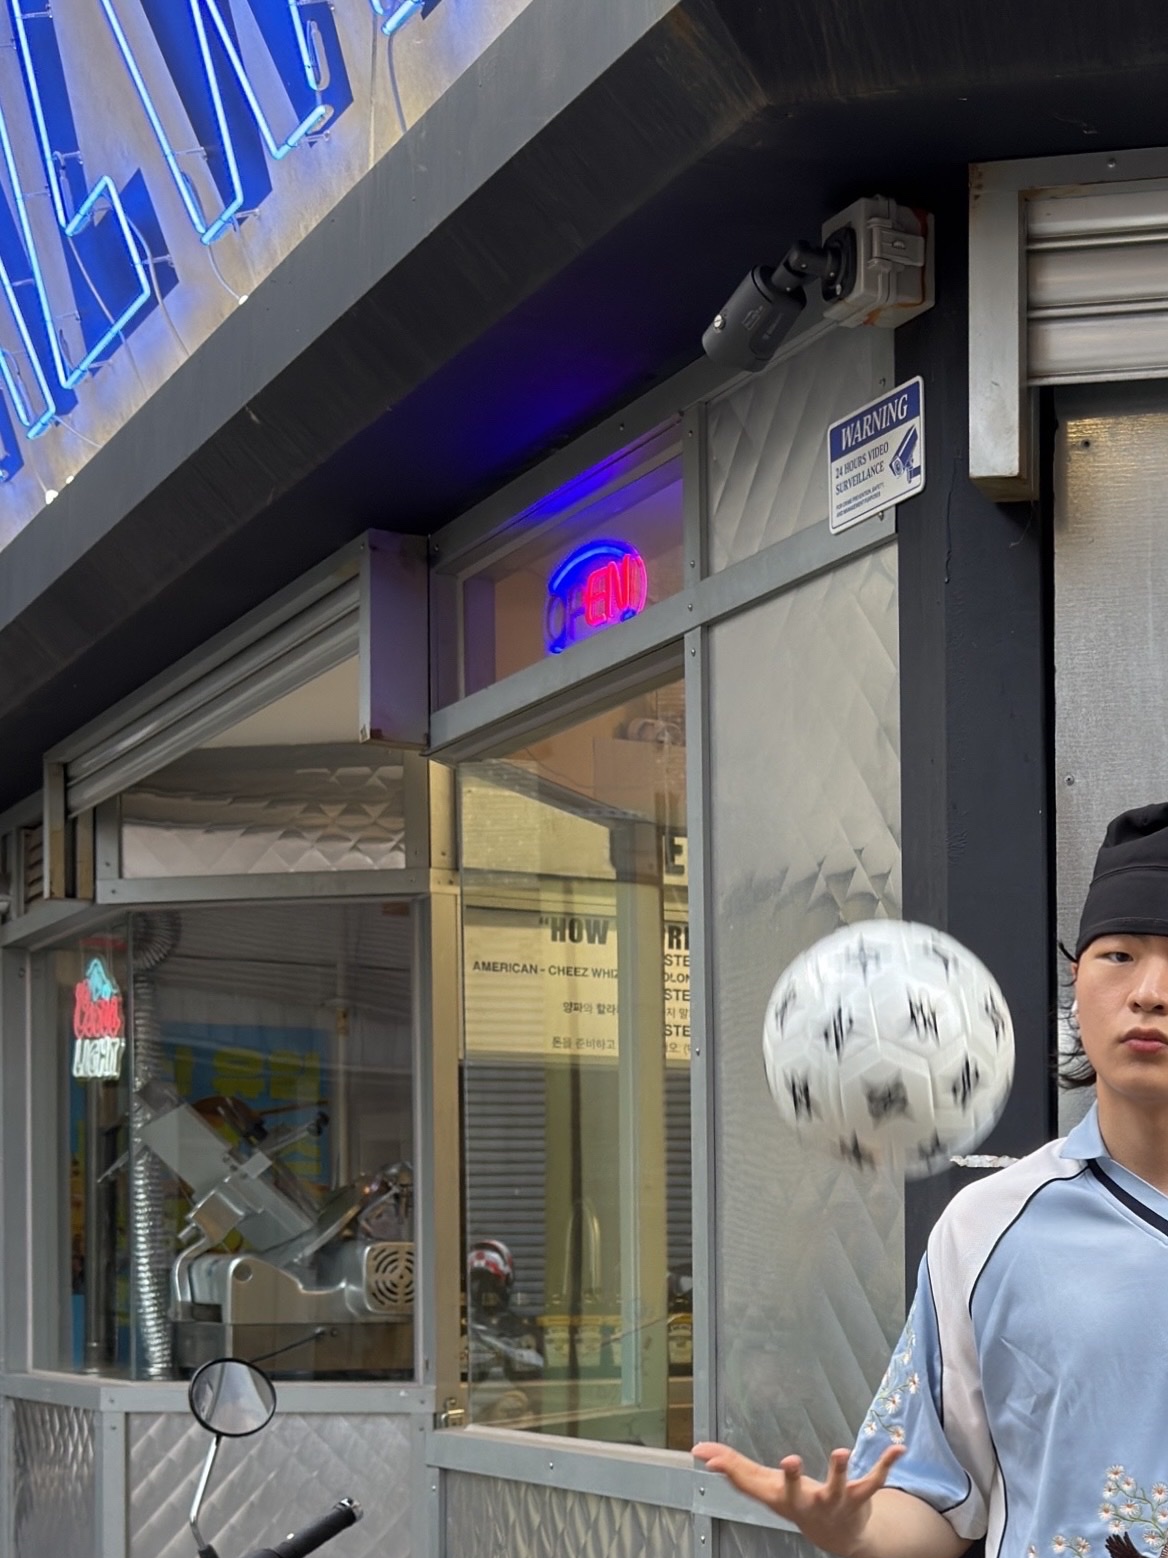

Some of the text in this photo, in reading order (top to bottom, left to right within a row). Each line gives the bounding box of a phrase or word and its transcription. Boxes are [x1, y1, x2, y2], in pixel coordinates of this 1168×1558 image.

[841, 394, 908, 450] WARNING
[835, 441, 889, 479] 24 HOURS VIDEO
[835, 460, 884, 495] SURVEILLANCE
[473, 961, 538, 975] AMERICAN
[548, 965, 588, 977] CHEEZ
